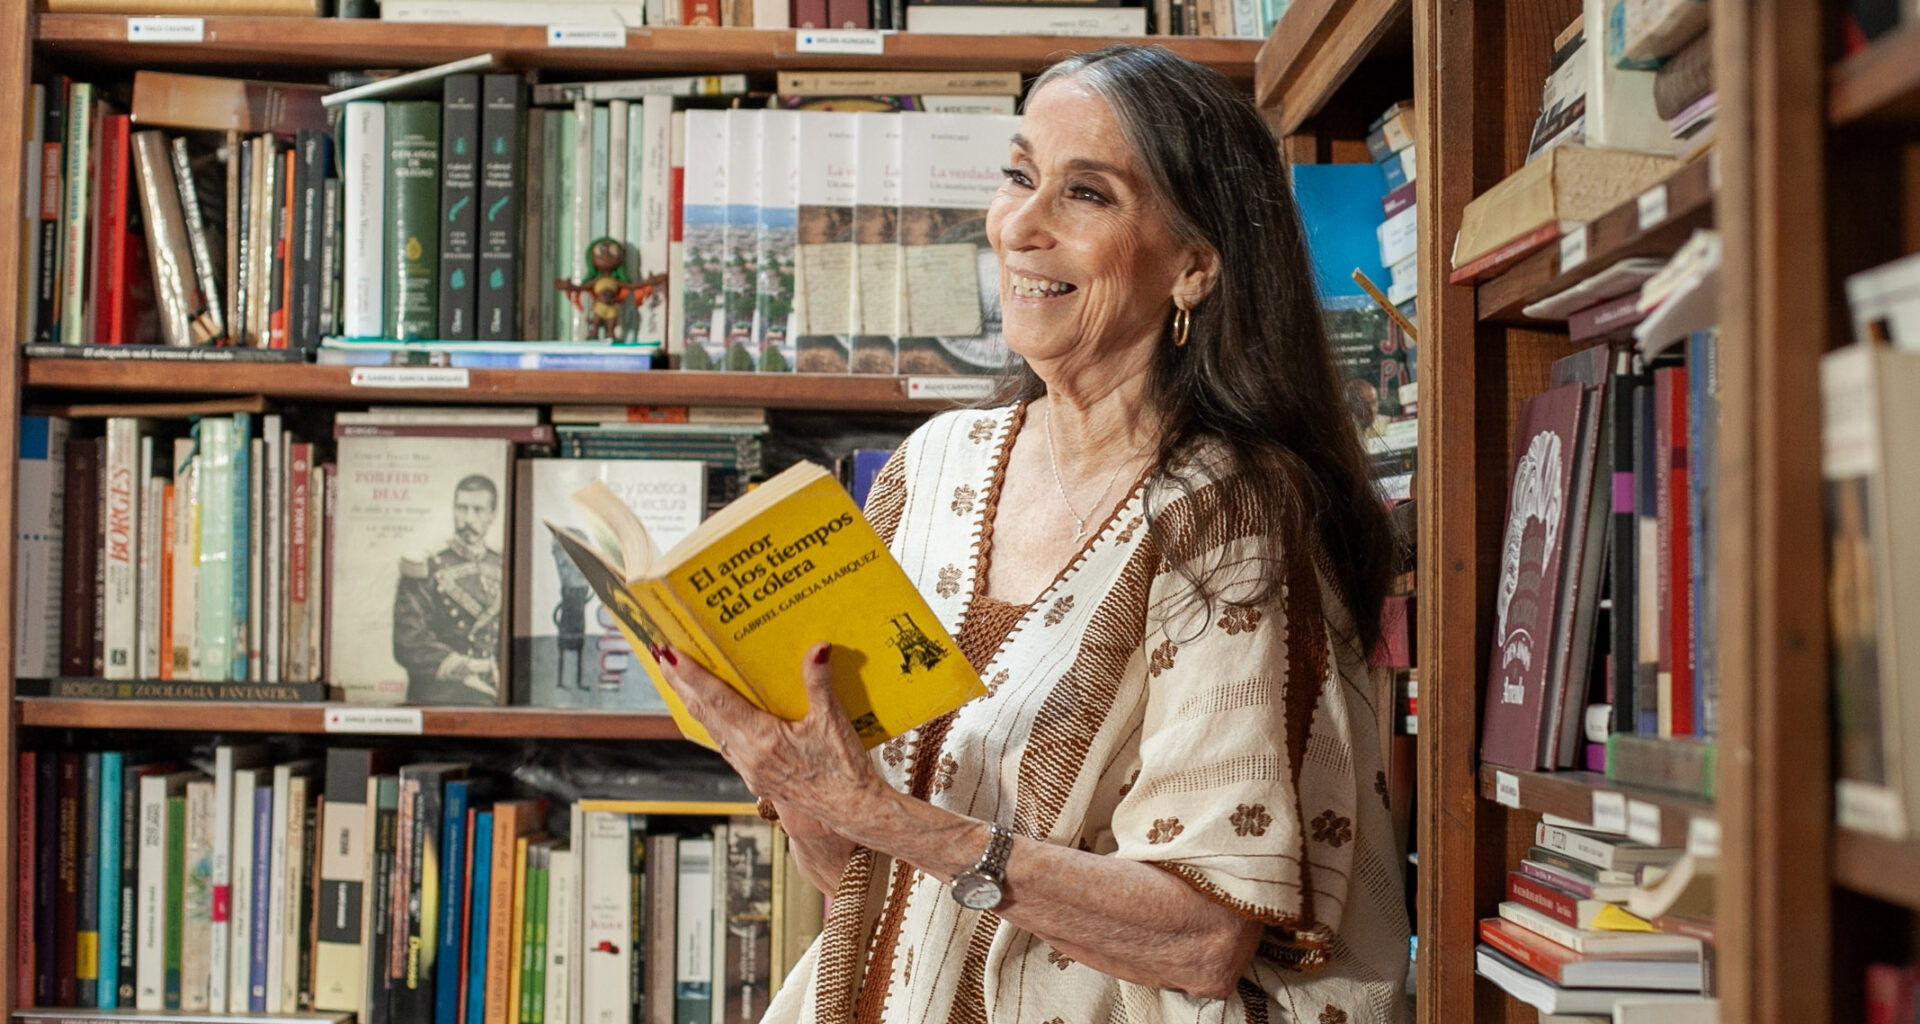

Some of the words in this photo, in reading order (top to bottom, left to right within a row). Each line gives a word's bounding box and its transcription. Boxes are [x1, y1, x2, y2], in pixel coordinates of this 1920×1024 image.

[930, 164, 947, 178] La
[355, 471, 430, 484] PORFIRIO
[626, 482, 637, 495] y
[637, 478, 687, 495] poética
[640, 496, 687, 511] lectura
[108, 467, 131, 563] BORGES
[688, 567, 717, 592] El
[718, 533, 774, 577] amor
[705, 585, 733, 609] en
[731, 565, 767, 590] los
[766, 511, 854, 568] tiempos
[719, 593, 752, 624] del
[752, 557, 816, 601] cólera
[733, 610, 780, 642] GABRIEL
[821, 549, 880, 587] MARQUEZ
[61, 682, 114, 697] BORGES
[406, 936, 421, 989] Donoso
